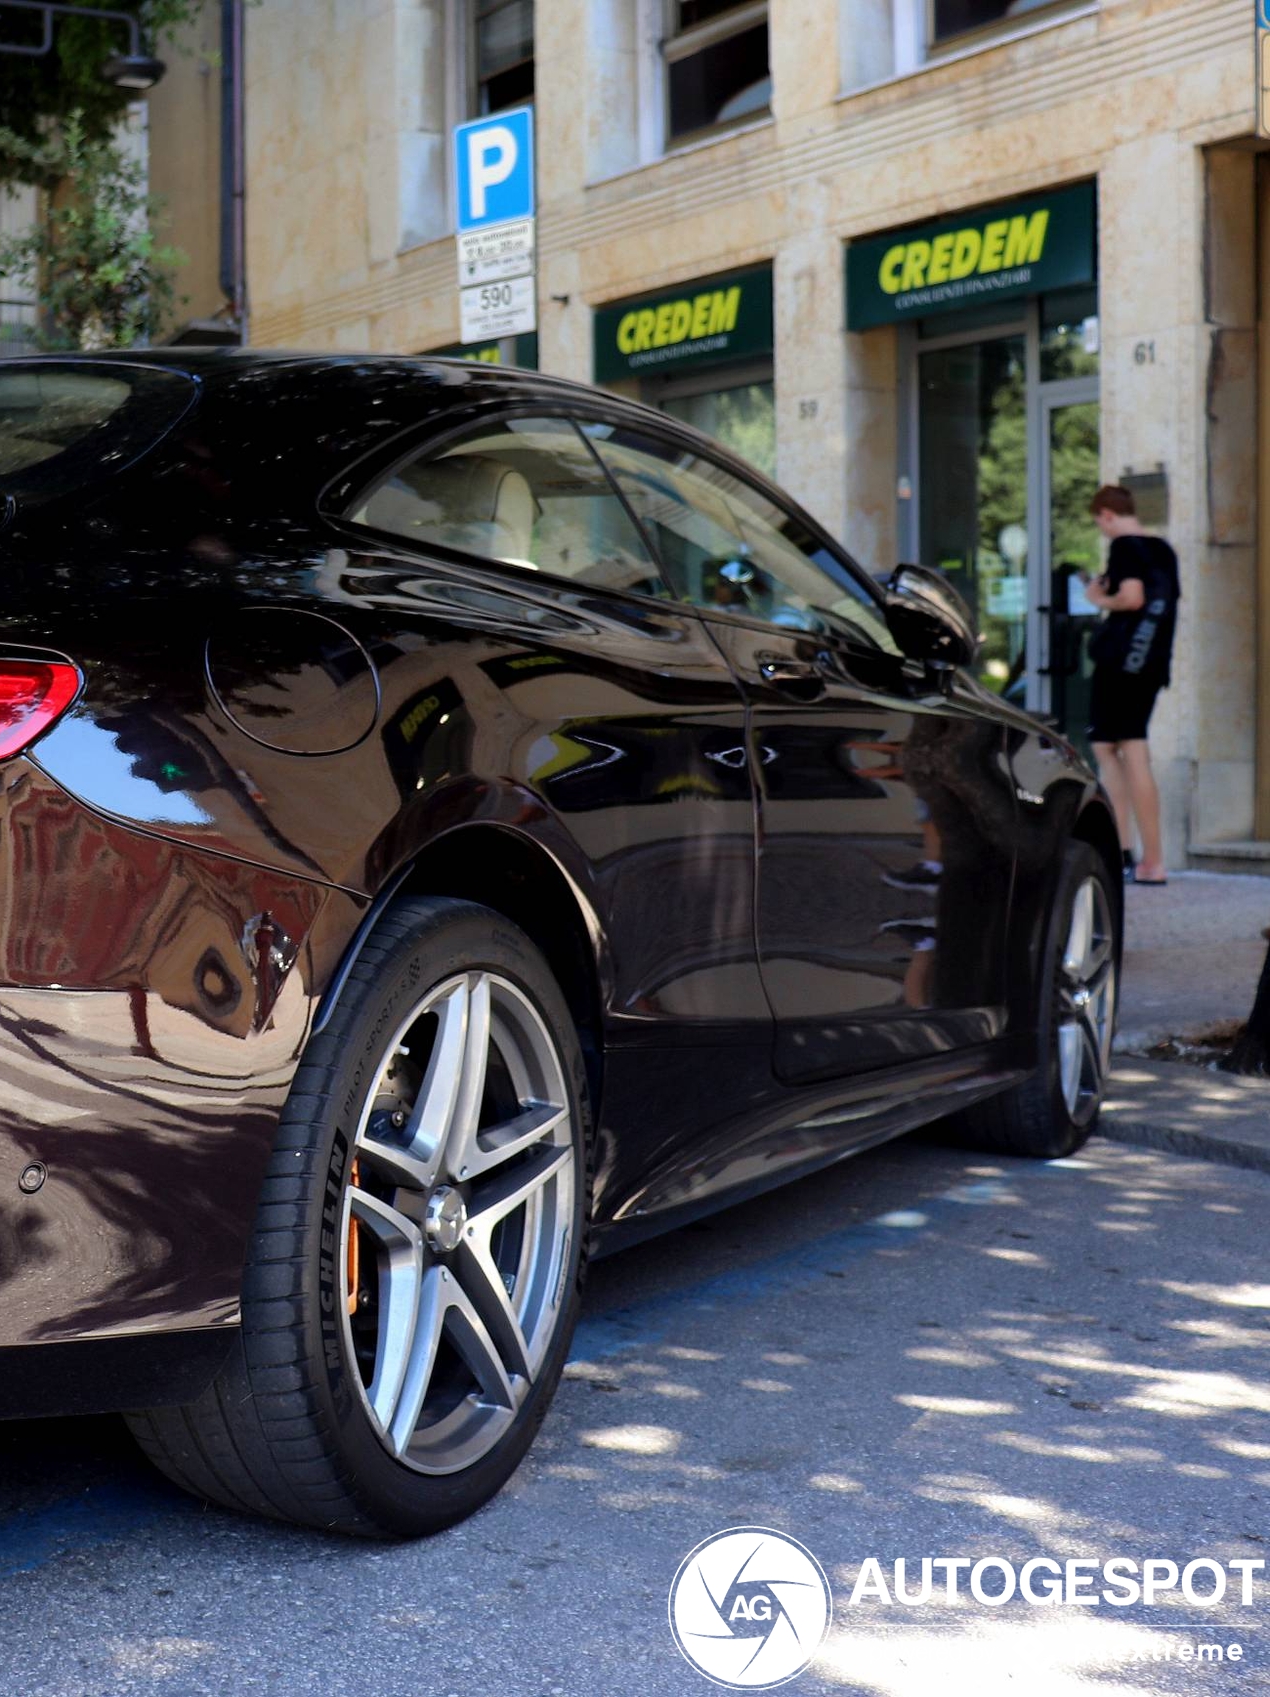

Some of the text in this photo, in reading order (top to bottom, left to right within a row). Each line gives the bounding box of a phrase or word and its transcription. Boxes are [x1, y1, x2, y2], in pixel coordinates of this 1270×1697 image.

[467, 126, 518, 219] P
[878, 209, 1049, 294] CREDEM
[480, 284, 512, 310] 590
[617, 286, 742, 355] CREDEM
[1134, 341, 1155, 366] 61
[343, 997, 393, 1117] PILOT SPORT
[319, 1139, 346, 1370] MICHELIN
